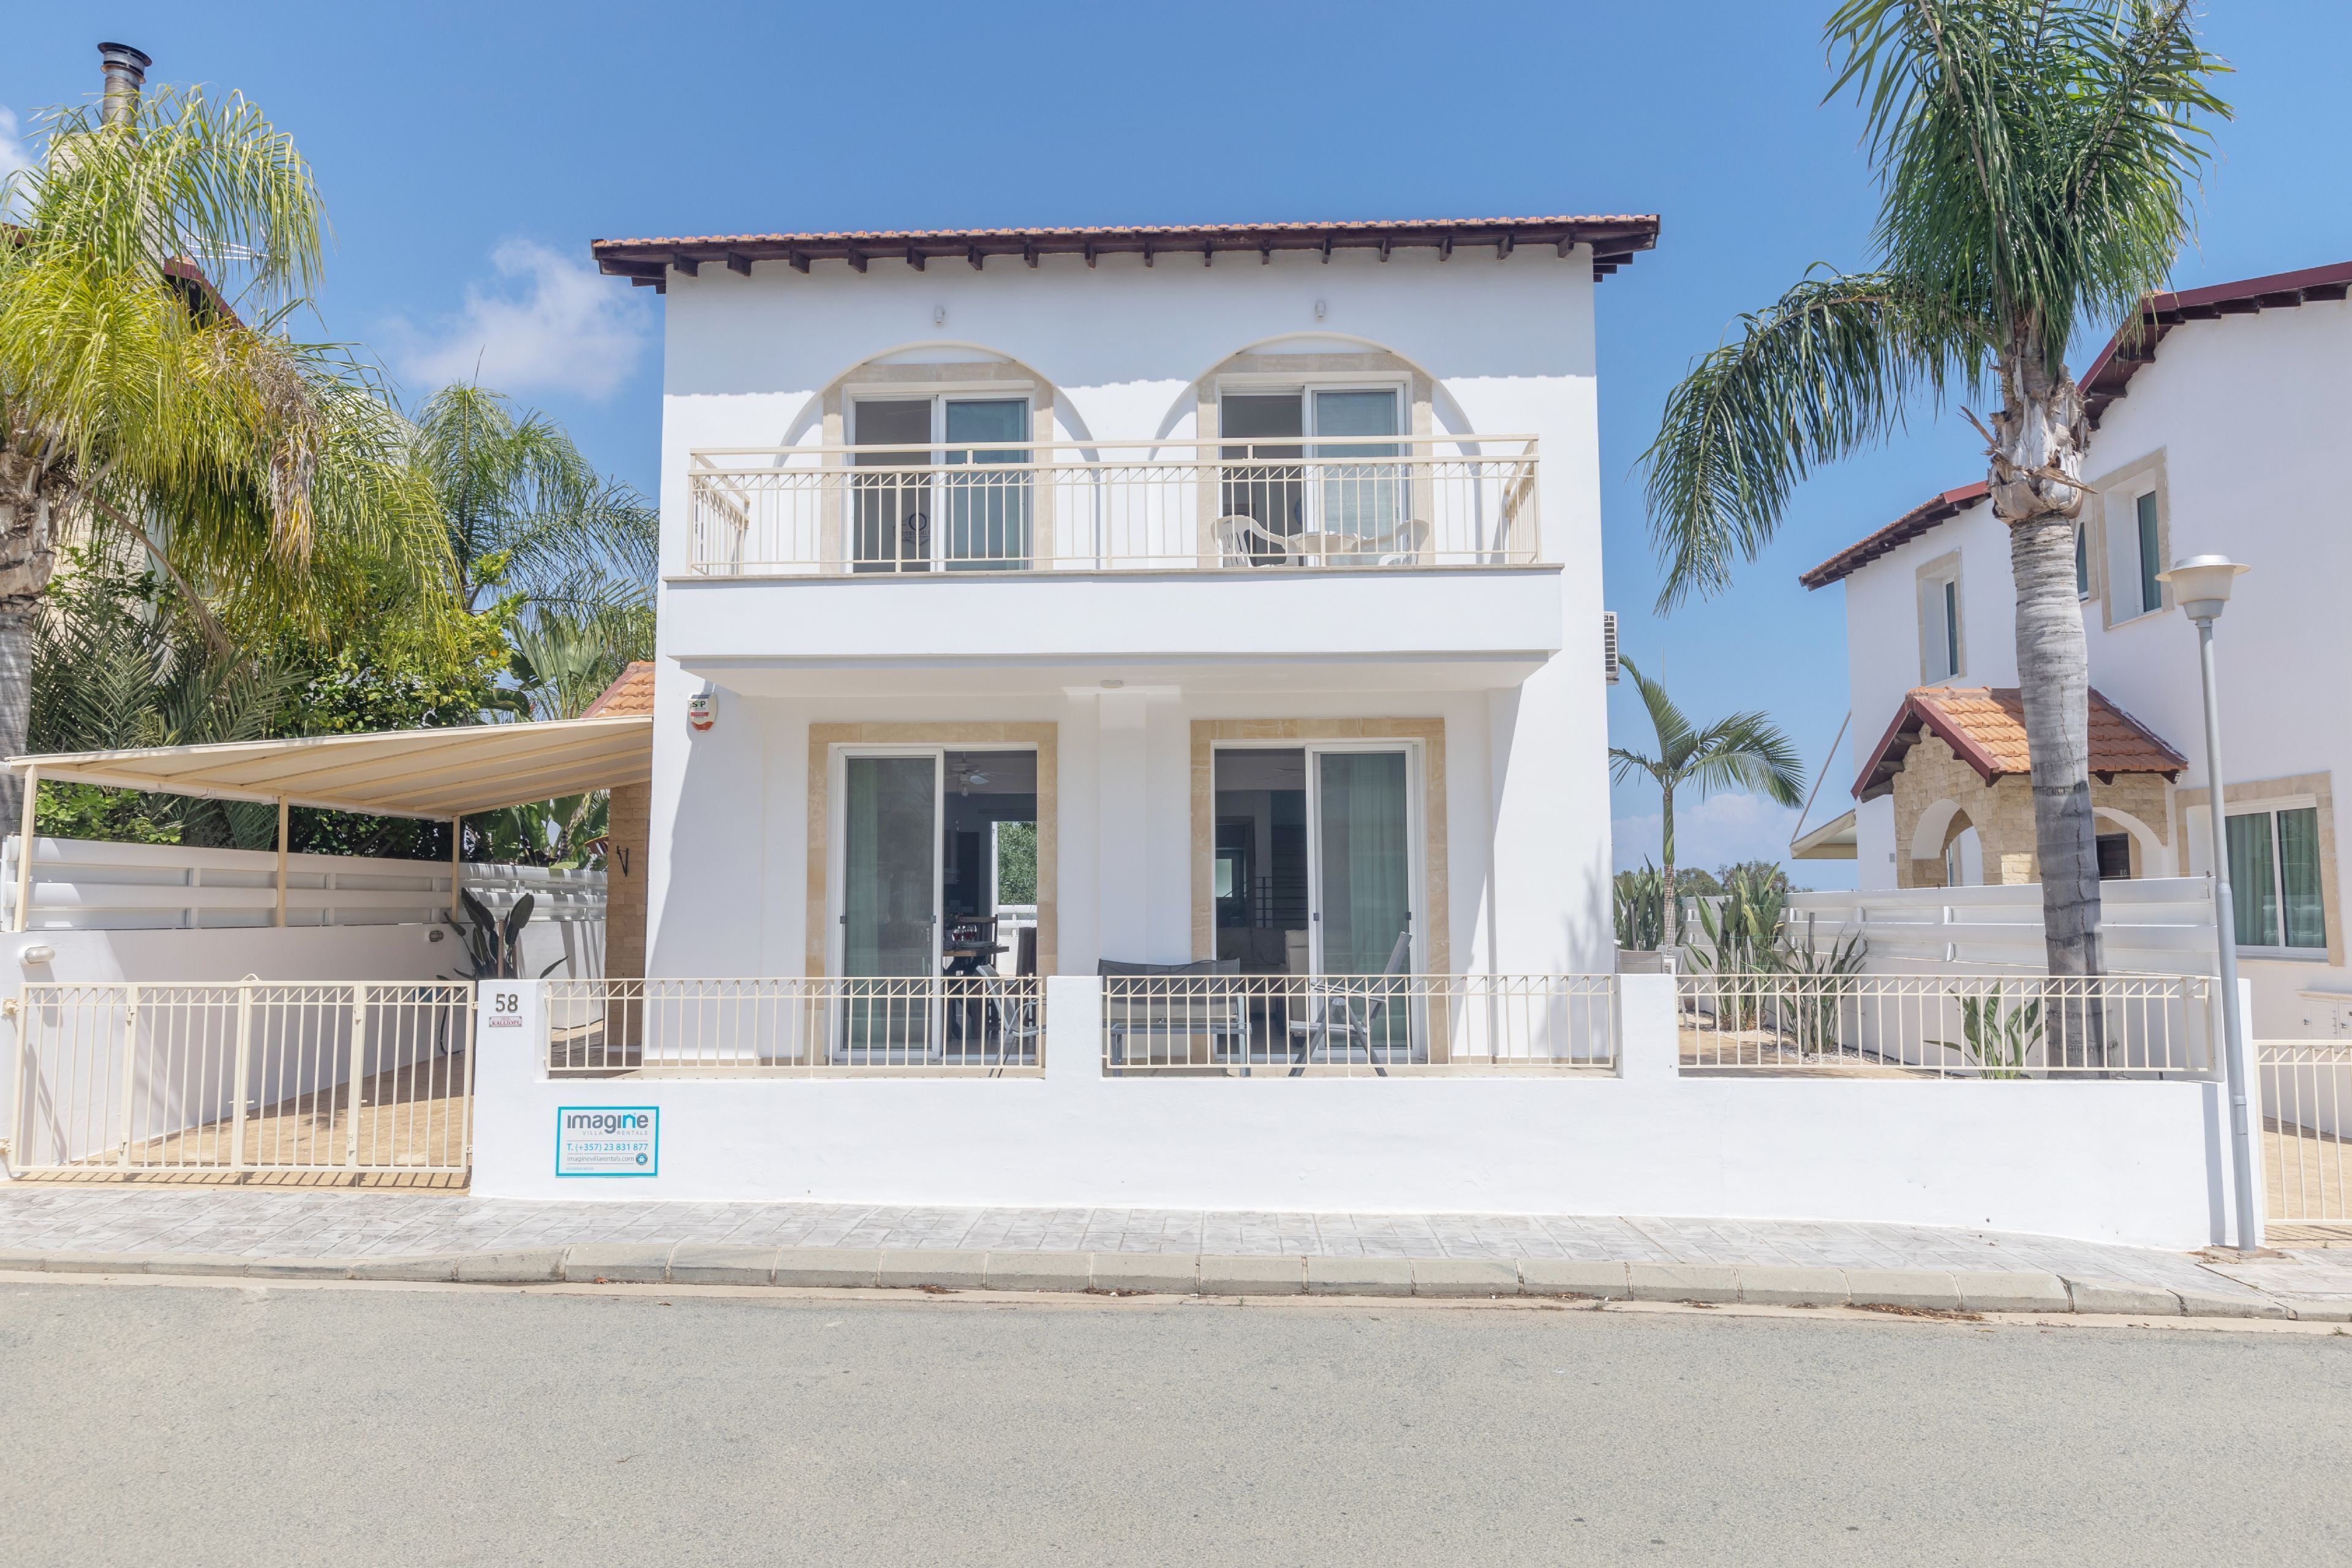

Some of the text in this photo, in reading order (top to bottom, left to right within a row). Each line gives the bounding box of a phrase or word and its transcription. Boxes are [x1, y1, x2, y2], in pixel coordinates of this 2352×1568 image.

[496, 993, 518, 1012] 58
[567, 1114, 649, 1134] imagine
[576, 1144, 601, 1152] (+357)
